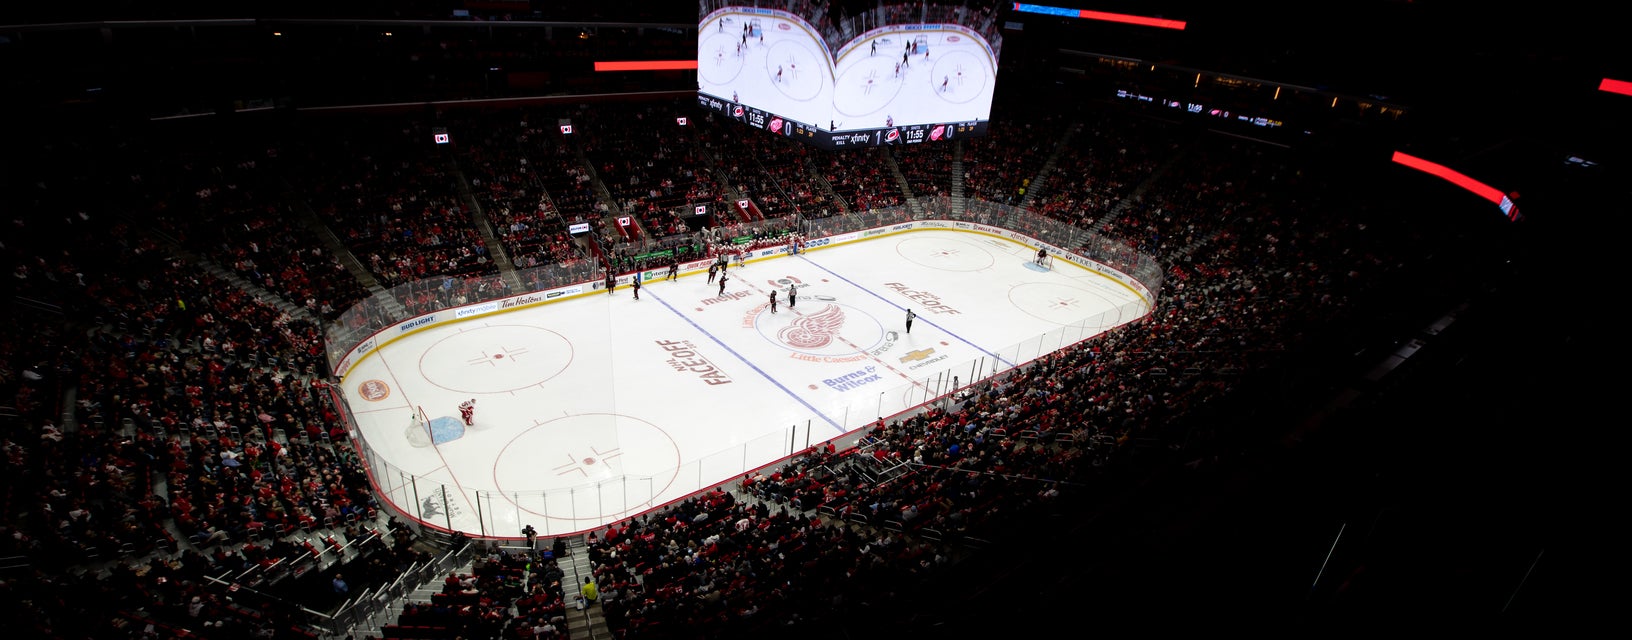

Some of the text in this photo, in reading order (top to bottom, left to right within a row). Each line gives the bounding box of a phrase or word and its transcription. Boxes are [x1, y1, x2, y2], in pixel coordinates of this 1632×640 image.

[726, 103, 730, 117] 1
[1188, 103, 1203, 111] 11:55
[749, 112, 764, 125] 11:55
[785, 121, 792, 136] 0
[906, 130, 924, 139] 11:55
[947, 125, 953, 139] 0
[850, 133, 870, 144] xfinity
[875, 130, 881, 145] 1
[1010, 232, 1028, 243] xfinity
[502, 296, 542, 309] Tim Hortons
[457, 304, 497, 317] xfinity mobile
[401, 316, 435, 331] BUD LIGHT
[655, 340, 732, 386] FACE-OFF
[790, 352, 868, 363] Little Caesars
[909, 354, 949, 371] CHEVROLET
[666, 358, 687, 372] NHL
[823, 365, 877, 387] Burns &
[832, 373, 883, 392] Wilcox
